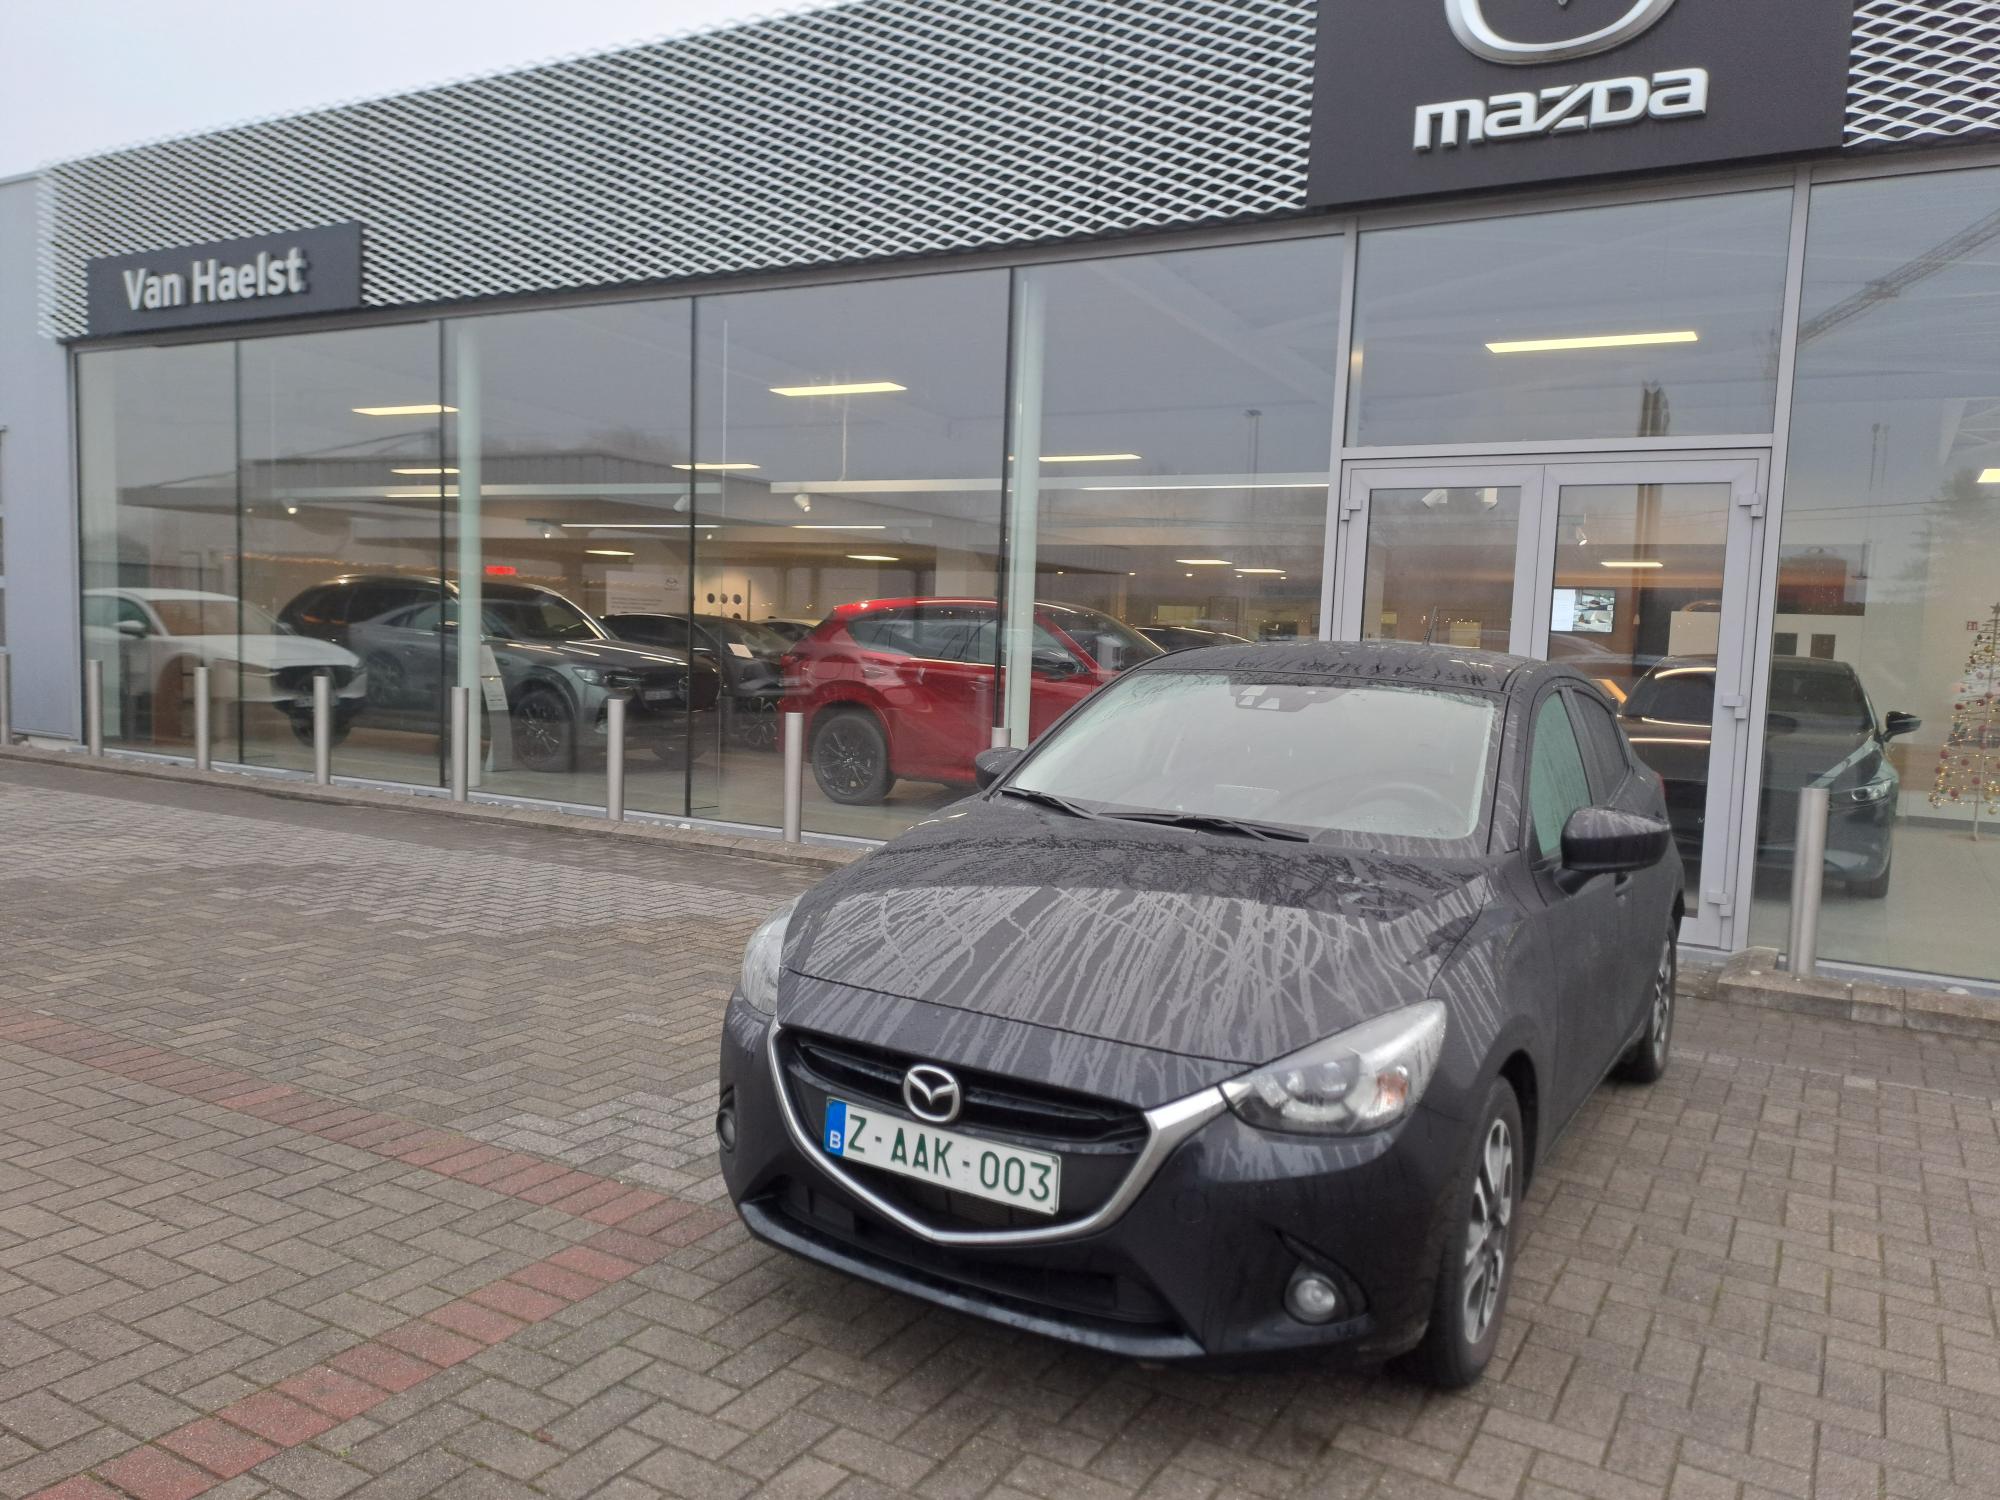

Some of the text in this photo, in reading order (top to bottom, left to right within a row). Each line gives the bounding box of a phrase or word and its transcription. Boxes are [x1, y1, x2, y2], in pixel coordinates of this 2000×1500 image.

[123, 247, 307, 311] Van Haelst
[829, 1113, 1052, 1202] B Z-AAK-003
